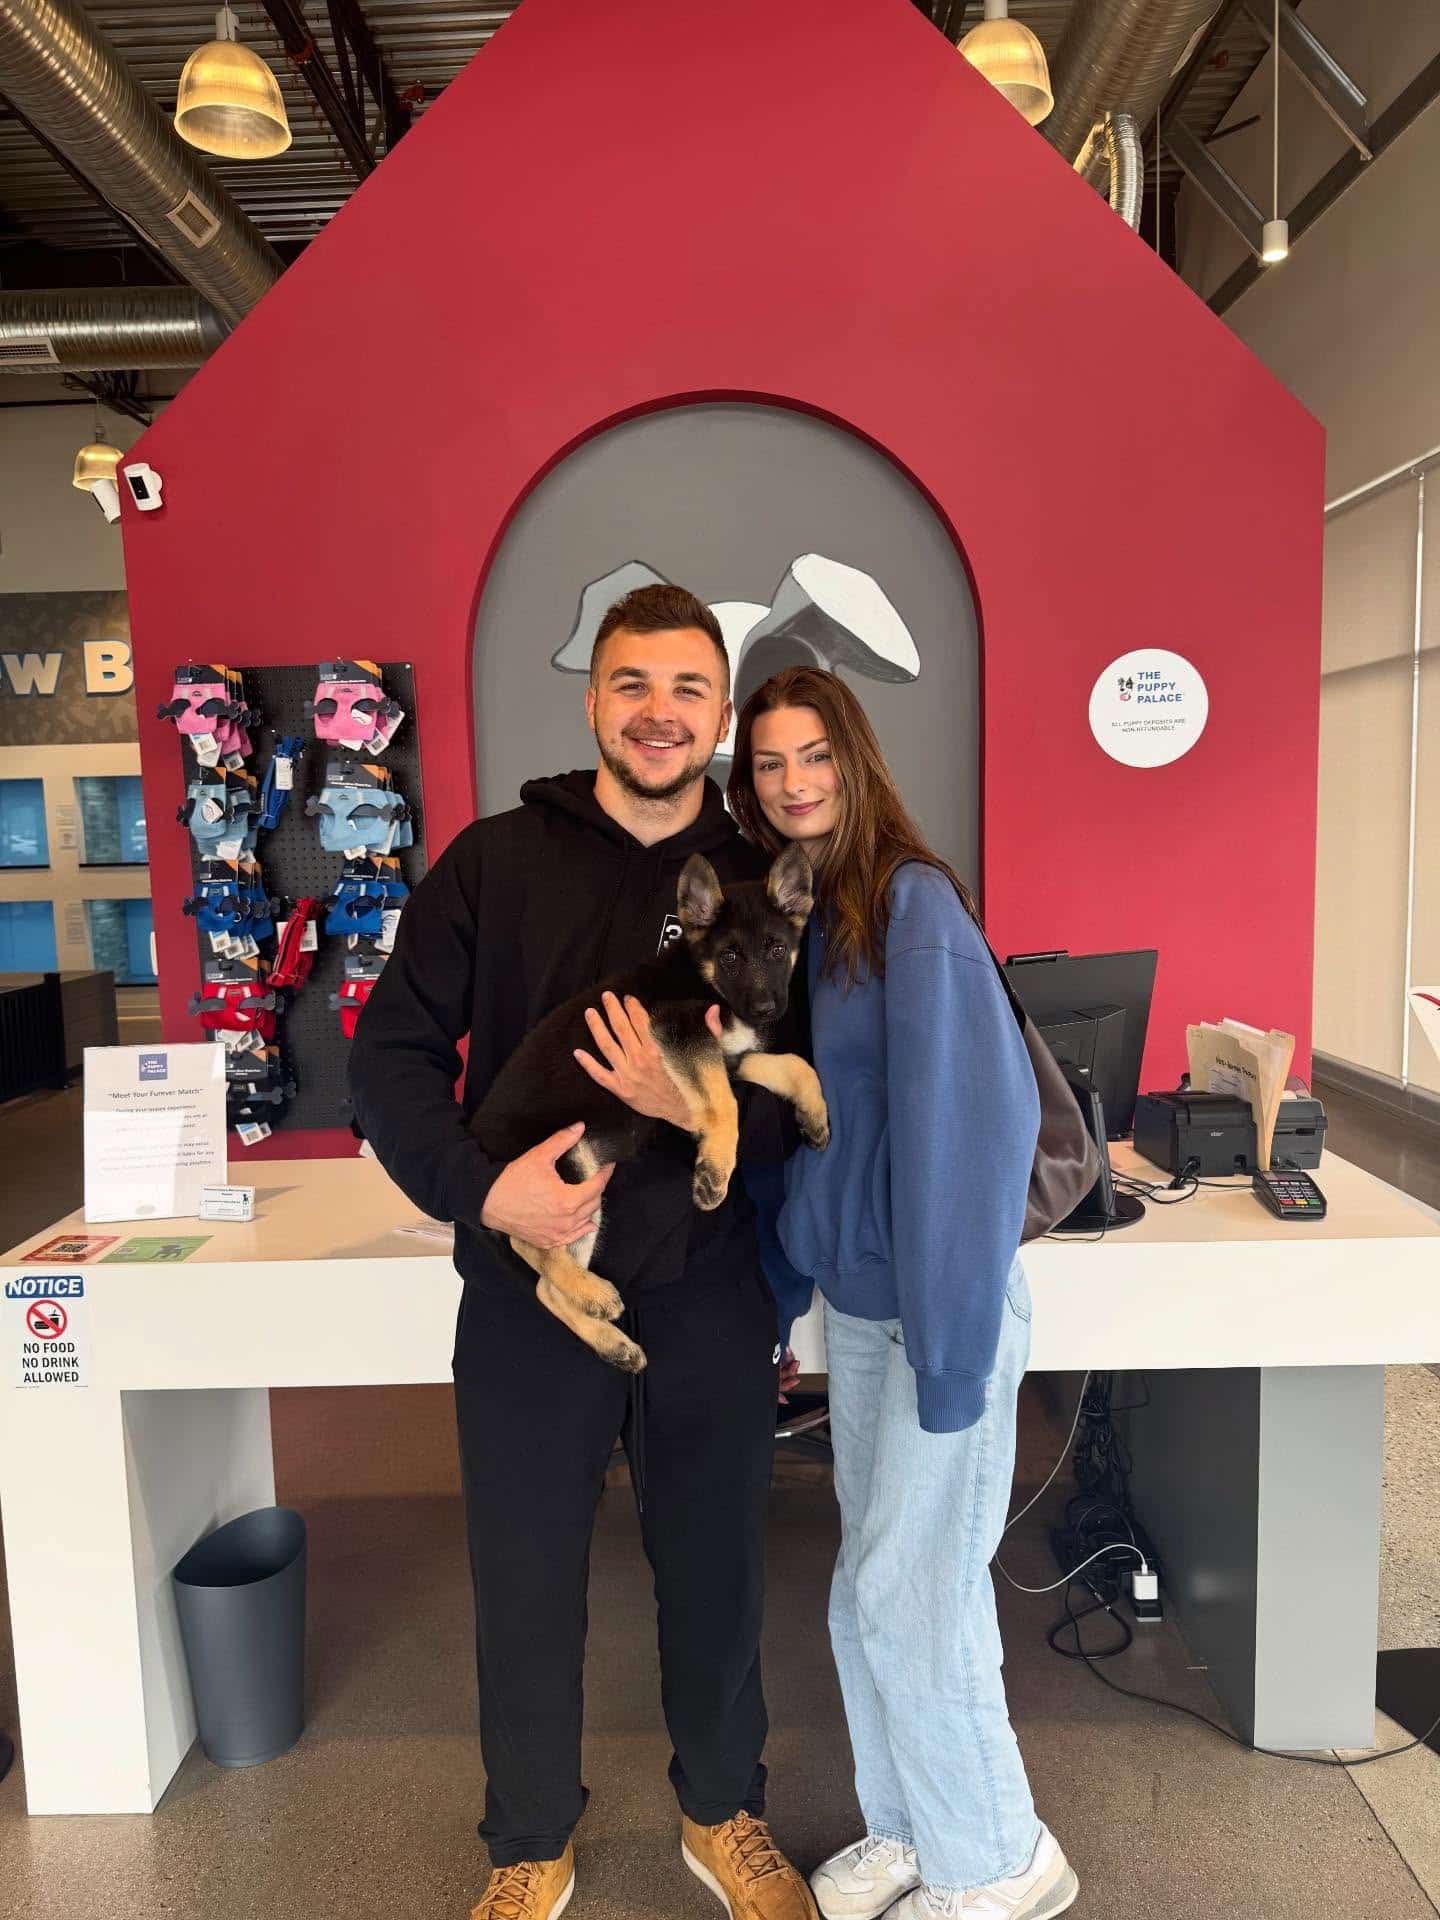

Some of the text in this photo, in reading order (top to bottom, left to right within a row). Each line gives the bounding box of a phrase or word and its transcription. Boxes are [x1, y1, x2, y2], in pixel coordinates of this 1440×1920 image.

[0, 652, 63, 695] w
[1136, 671, 1161, 680] THE
[1137, 682, 1176, 692] PUPPY
[1137, 693, 1182, 704] PALACE
[7, 1278, 82, 1296] NOTICE
[23, 1342, 75, 1354] NO FOOD
[22, 1356, 80, 1368] NO DRINK
[23, 1371, 79, 1383] ALLOWED
